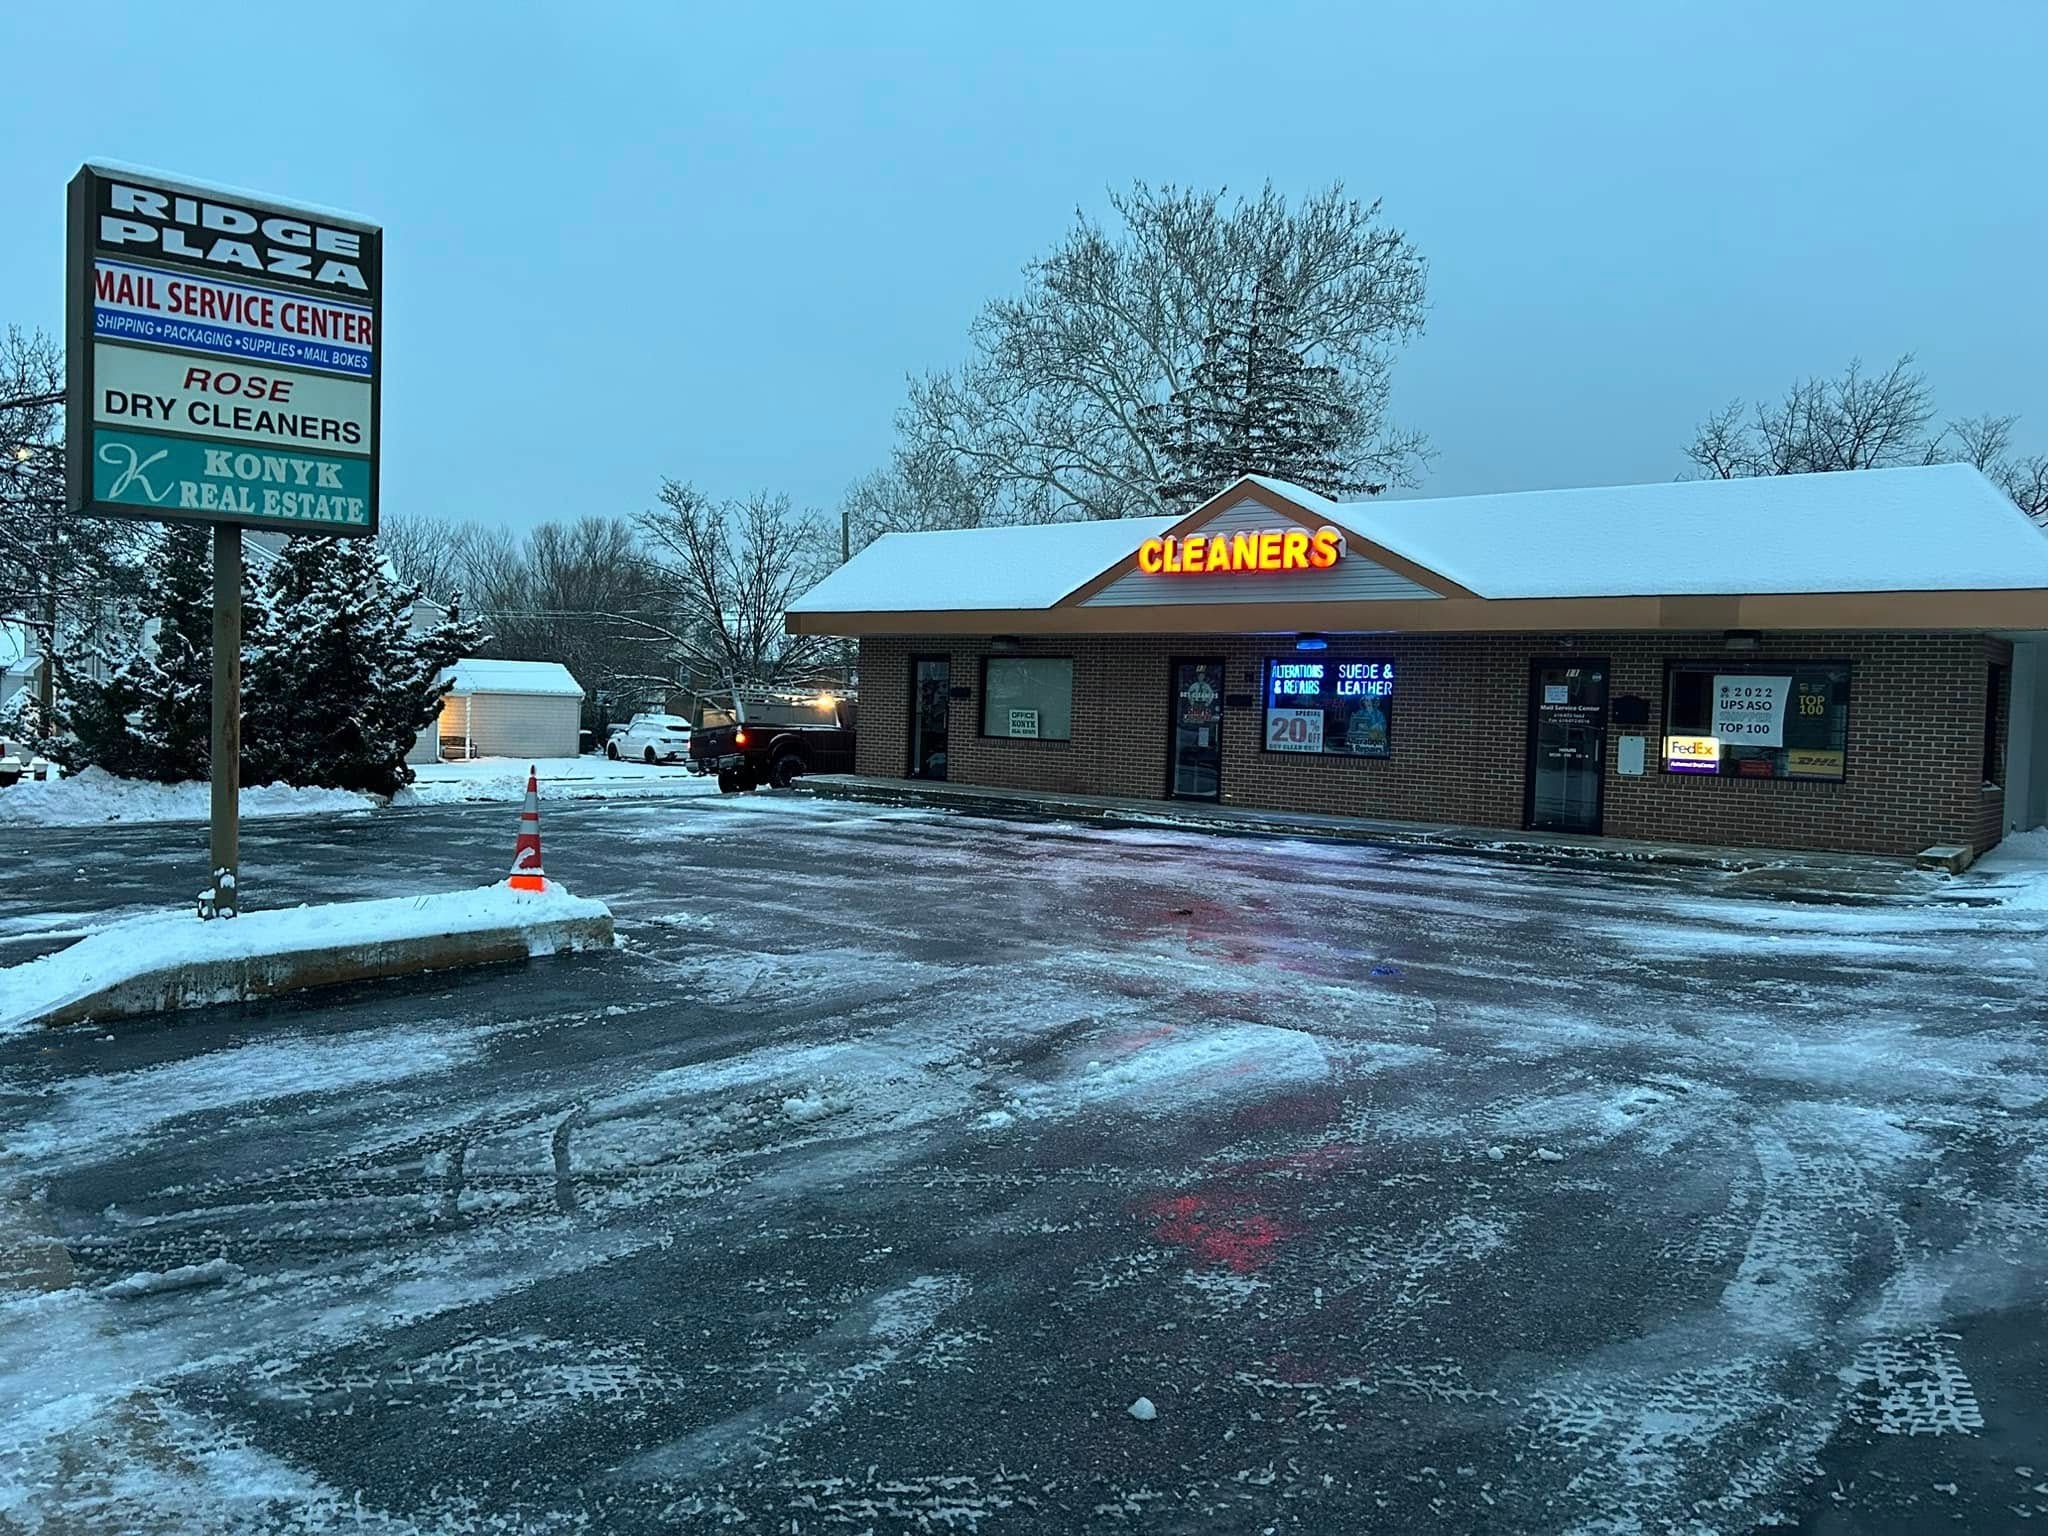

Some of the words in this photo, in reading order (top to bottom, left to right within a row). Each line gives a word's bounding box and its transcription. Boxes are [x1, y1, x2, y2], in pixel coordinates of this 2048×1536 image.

[110, 183, 360, 258] RIDGE
[100, 215, 369, 290] PLAZA
[94, 268, 160, 310] MAIL
[167, 281, 274, 329] SERVICE
[280, 302, 372, 345] CENTER
[96, 313, 155, 335] SHIPPING
[163, 323, 233, 348] PACKAGING
[241, 336, 296, 358] SUPPLIES
[303, 346, 330, 365] MAIL
[332, 351, 369, 370] BOXES
[184, 367, 294, 403] ROSE
[104, 390, 176, 421] DRY
[188, 401, 361, 444] CLEANERS
[203, 448, 344, 490] KONYK
[179, 480, 256, 513] REAL
[262, 491, 365, 524] ESTATE
[1139, 529, 1339, 575] CLEANERS
[1338, 664, 1379, 679] SUEDE
[1382, 664, 1394, 678] &
[1274, 680, 1282, 694] &
[1337, 681, 1393, 695] LEATHER
[1734, 687, 1773, 698] 2022
[1720, 700, 1744, 710] UPS
[1746, 700, 1772, 711] ASO
[1798, 695, 1825, 705] TOP
[1799, 704, 1825, 715] 100
[1719, 723, 1743, 733] TOP
[1746, 724, 1770, 735] 100
[1308, 732, 1321, 743] OFF
[1672, 741, 1713, 755] FedEx
